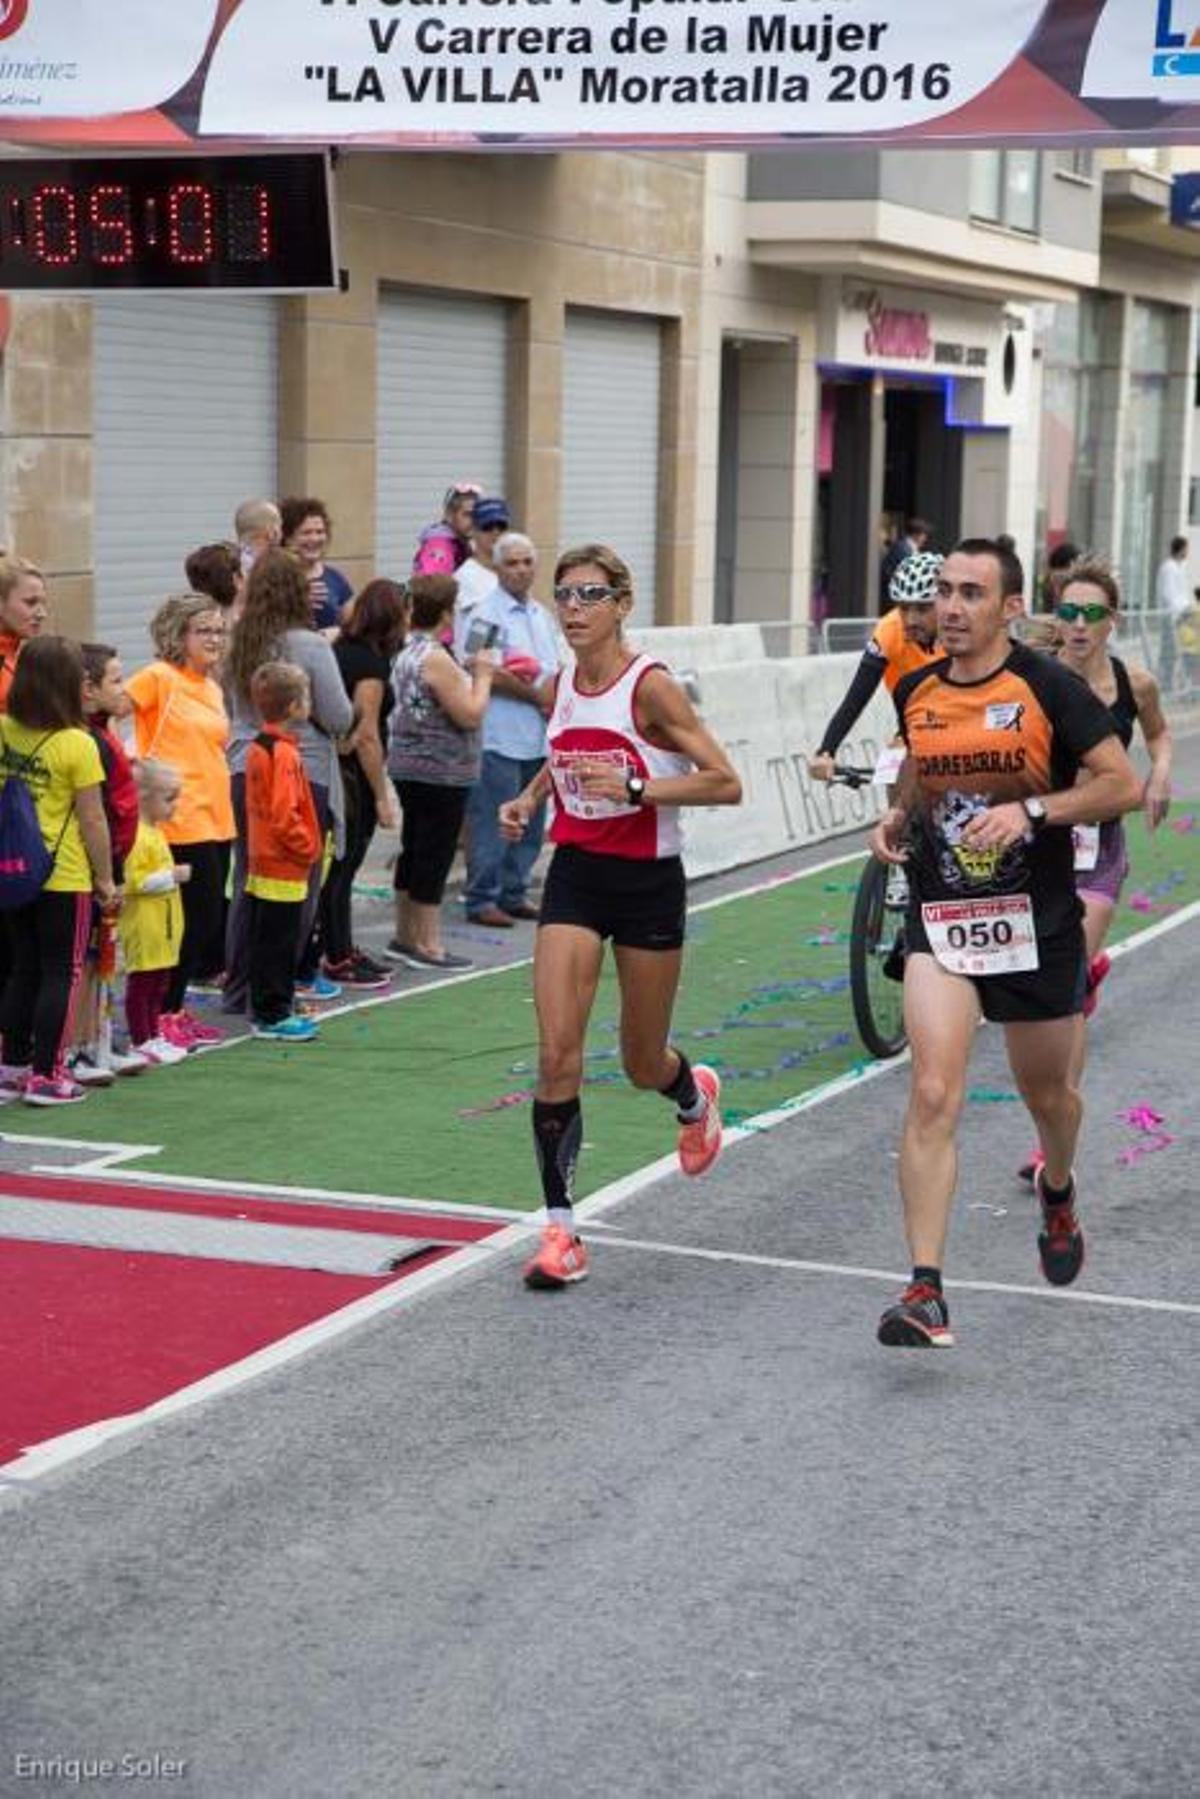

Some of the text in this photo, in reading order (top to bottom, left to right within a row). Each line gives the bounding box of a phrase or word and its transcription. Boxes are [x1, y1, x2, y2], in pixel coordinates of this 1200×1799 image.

[369, 14, 888, 61] V Carrera de la Mujer
[1155, 0, 1200, 48] L
[305, 63, 951, 103] "LA VILLA" Moratalla 2016
[947, 919, 1013, 949] 050
